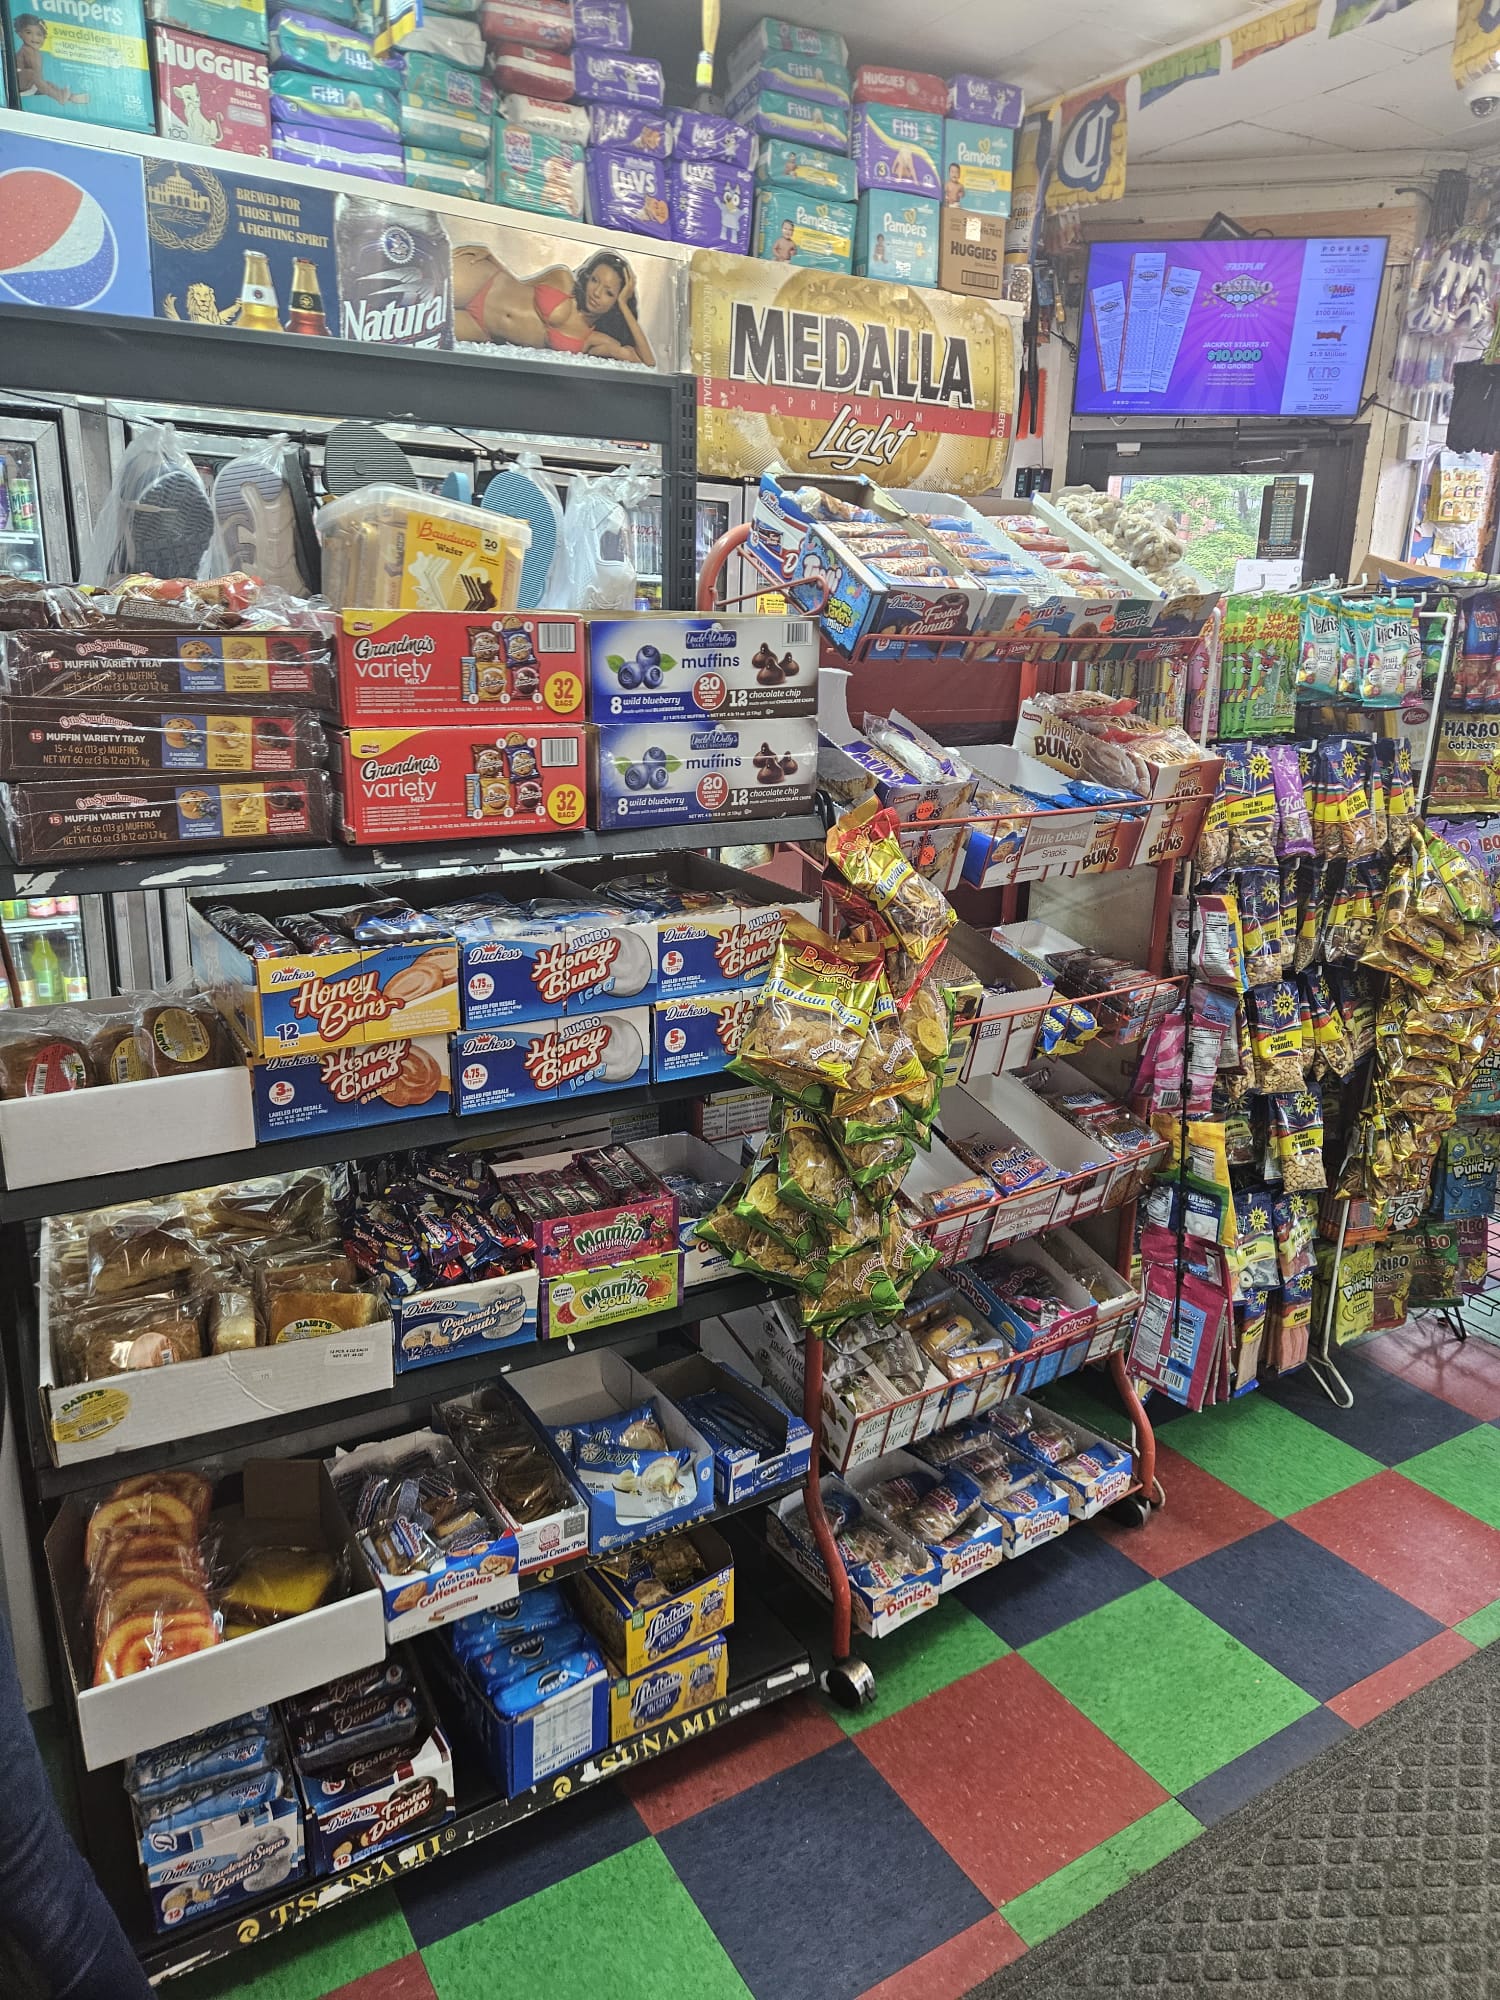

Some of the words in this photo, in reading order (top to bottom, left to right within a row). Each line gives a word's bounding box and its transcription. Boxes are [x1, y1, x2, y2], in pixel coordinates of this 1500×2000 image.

[156, 35, 270, 90] HUGGIES
[862, 70, 906, 88] HUGGIES
[957, 142, 1002, 168] Pampers
[235, 187, 279, 207] BREWED
[280, 196, 301, 212] FOR
[236, 204, 271, 223] THOSE
[272, 212, 300, 228] WITH
[884, 211, 927, 238] Pampers
[238, 222, 245, 234] A
[246, 222, 296, 245] FIGHTING
[296, 231, 329, 249] SPIRIT
[950, 240, 998, 262] HUGGIES
[343, 277, 449, 342] Natural
[728, 301, 976, 410] MEDALLA
[1206, 348, 1263, 364] $10,000
[702, 352, 714, 441] MUNDIALMENTE
[787, 395, 924, 424] PREMIUM
[808, 403, 918, 471] Light
[416, 518, 478, 549] Bauducco
[435, 541, 464, 558] Wafer
[924, 604, 963, 623] Frosted
[354, 633, 436, 660] Grandma's
[64, 660, 99, 669] MUFFIN
[100, 659, 138, 668] VARIETY
[140, 659, 163, 668] TRAY
[354, 658, 432, 683] variety
[681, 652, 741, 670] muffins
[404, 677, 420, 685] MIX
[553, 677, 574, 699] 32
[699, 676, 720, 690] 20
[610, 696, 623, 715] 8
[622, 696, 641, 706] wild
[641, 694, 681, 710] blueberry
[729, 689, 748, 707] 12
[749, 689, 782, 699] chocolate
[782, 688, 802, 700] chip
[46, 733, 81, 741] MUFFIN
[82, 733, 121, 742] VARIETY
[122, 735, 146, 743] TRAY
[1044, 719, 1077, 748] Honey
[43, 755, 58, 764] NET
[59, 755, 72, 764] WT
[73, 755, 84, 764] 60
[110, 756, 118, 765] 12
[107, 745, 139, 755] MUFFINS
[685, 754, 742, 770] muffins
[1034, 735, 1084, 770] BUNS
[360, 754, 441, 782] Grandma's
[361, 777, 437, 802] variety
[703, 776, 723, 790] 20
[556, 790, 577, 811] 32
[617, 798, 629, 816] 8
[629, 797, 647, 807] wild
[647, 795, 685, 811] blueberry
[731, 788, 749, 806] 12
[749, 788, 780, 798] chocolate
[780, 787, 799, 799] chip
[64, 813, 99, 824] MUFFIN
[99, 811, 137, 821] VARIETY
[138, 809, 162, 819] TRAY
[1029, 834, 1055, 846] Little
[1055, 828, 1088, 843] Debbie
[1041, 848, 1067, 859] Snacks
[571, 928, 610, 950] JUMBO
[662, 926, 709, 944] Duchess
[715, 920, 787, 957] Honey
[467, 949, 523, 965] Duchess
[531, 938, 619, 978] Honey
[667, 951, 677, 967] 5
[720, 937, 778, 975] Buns
[799, 945, 860, 979] Bemar
[269, 969, 315, 985] Duchess
[470, 977, 486, 989] 4.75
[538, 957, 608, 1001] Buns
[817, 973, 852, 990] SNACKS
[292, 971, 377, 1015] Honey
[578, 976, 616, 1005] Iced
[766, 978, 826, 1007] Plantain
[830, 996, 863, 1027] Chips
[317, 994, 402, 1039] Buns
[665, 1004, 711, 1021] Duchess
[1278, 1001, 1290, 1010] 99
[276, 1023, 299, 1041] 12
[563, 1016, 601, 1039] JUMBO
[979, 1029, 1001, 1040] TEXAS
[461, 1038, 517, 1056] Duchess
[524, 1026, 611, 1067] Honey
[1270, 1039, 1294, 1052] Peanuts
[322, 1038, 408, 1081] Honey
[531, 1045, 599, 1090] Buns
[276, 1083, 287, 1096] 3
[329, 1056, 399, 1100] Buns
[1452, 1161, 1495, 1179] PUNCH
[573, 1223, 644, 1256] Mamba
[581, 1278, 648, 1311] Mamba
[598, 1294, 631, 1313] SOUR
[404, 1300, 458, 1318] Duchess
[440, 1306, 492, 1334] Powdered
[491, 1297, 523, 1314] Sugar
[294, 1319, 337, 1331] DAISY'S
[450, 1316, 498, 1342] Donuts
[1095, 1475, 1127, 1502] Danish
[1023, 1513, 1061, 1541] Danish
[519, 1550, 548, 1569] Oatmeal
[549, 1545, 570, 1560] Creme
[570, 1538, 586, 1554] Pies
[951, 1547, 993, 1576] Danish
[418, 1583, 459, 1610] Coffee
[458, 1574, 494, 1597] Cakes
[437, 1569, 476, 1591] Hostess
[885, 1585, 932, 1617] Danish
[380, 1783, 432, 1820] Frosted
[367, 1799, 430, 1842] Donuts
[200, 1852, 253, 1889] Powdered
[252, 1838, 287, 1860] Sugar
[212, 1862, 261, 1895] Donuts
